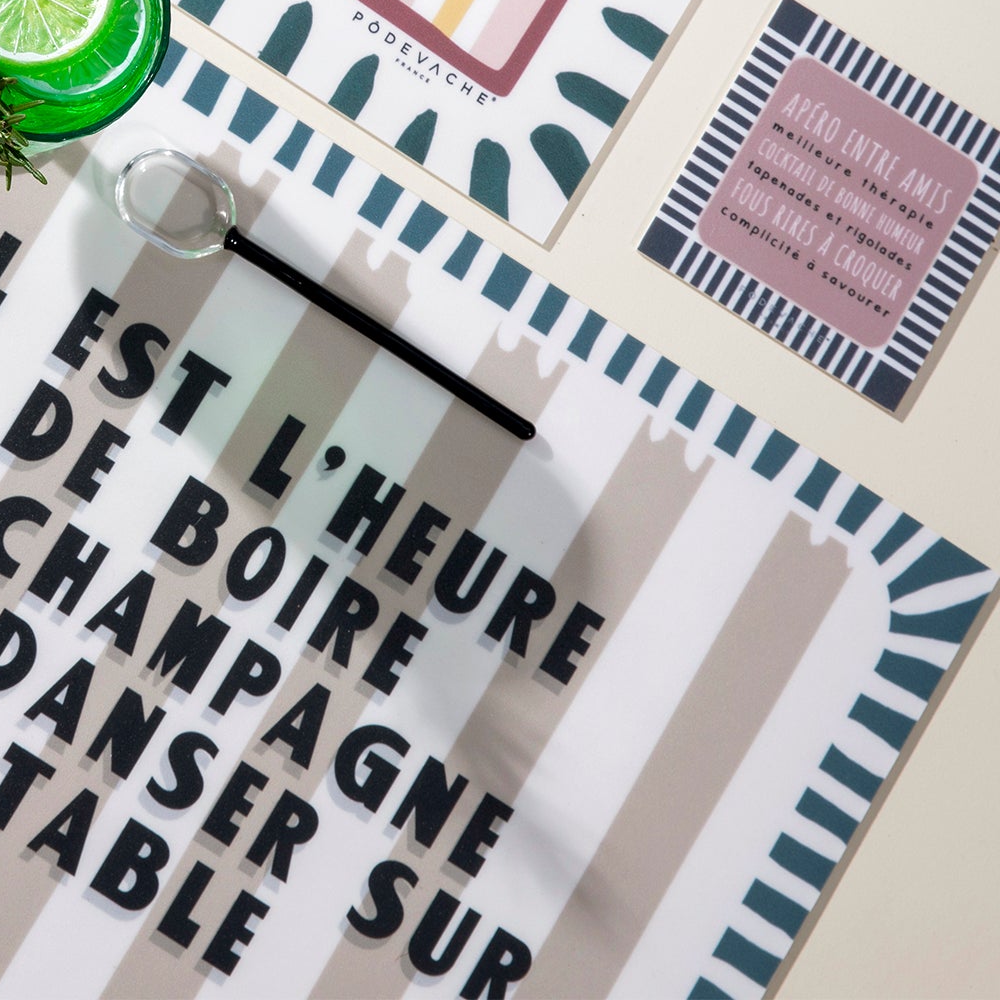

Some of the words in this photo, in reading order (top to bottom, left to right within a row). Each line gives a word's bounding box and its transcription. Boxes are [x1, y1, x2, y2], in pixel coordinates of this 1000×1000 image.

[757, 138, 819, 187] COCKTAIL
[816, 176, 838, 198] DE
[834, 187, 877, 226] BONNE
[876, 212, 926, 256] HUMEUR
[772, 121, 853, 178] meilleure
[860, 177, 935, 231] thérapie
[780, 92, 841, 144] APÉRO
[841, 129, 901, 182] ENTRE
[898, 168, 953, 215] AMIS
[720, 205, 801, 261] complicité
[805, 258, 816, 272] à
[820, 270, 892, 318] savourer
[731, 178, 775, 217] FOUS
[772, 204, 819, 248] RIRES
[833, 244, 904, 302] CROQUER
[747, 159, 822, 212] tapenades
[825, 211, 843, 226] et
[845, 222, 913, 272] rigolades
[1, 379, 132, 504] DE
[148, 475, 428, 697] BOIRE
[50, 287, 233, 438] EST
[248, 415, 607, 688] L'HEURE
[345, 860, 533, 1000] SUR
